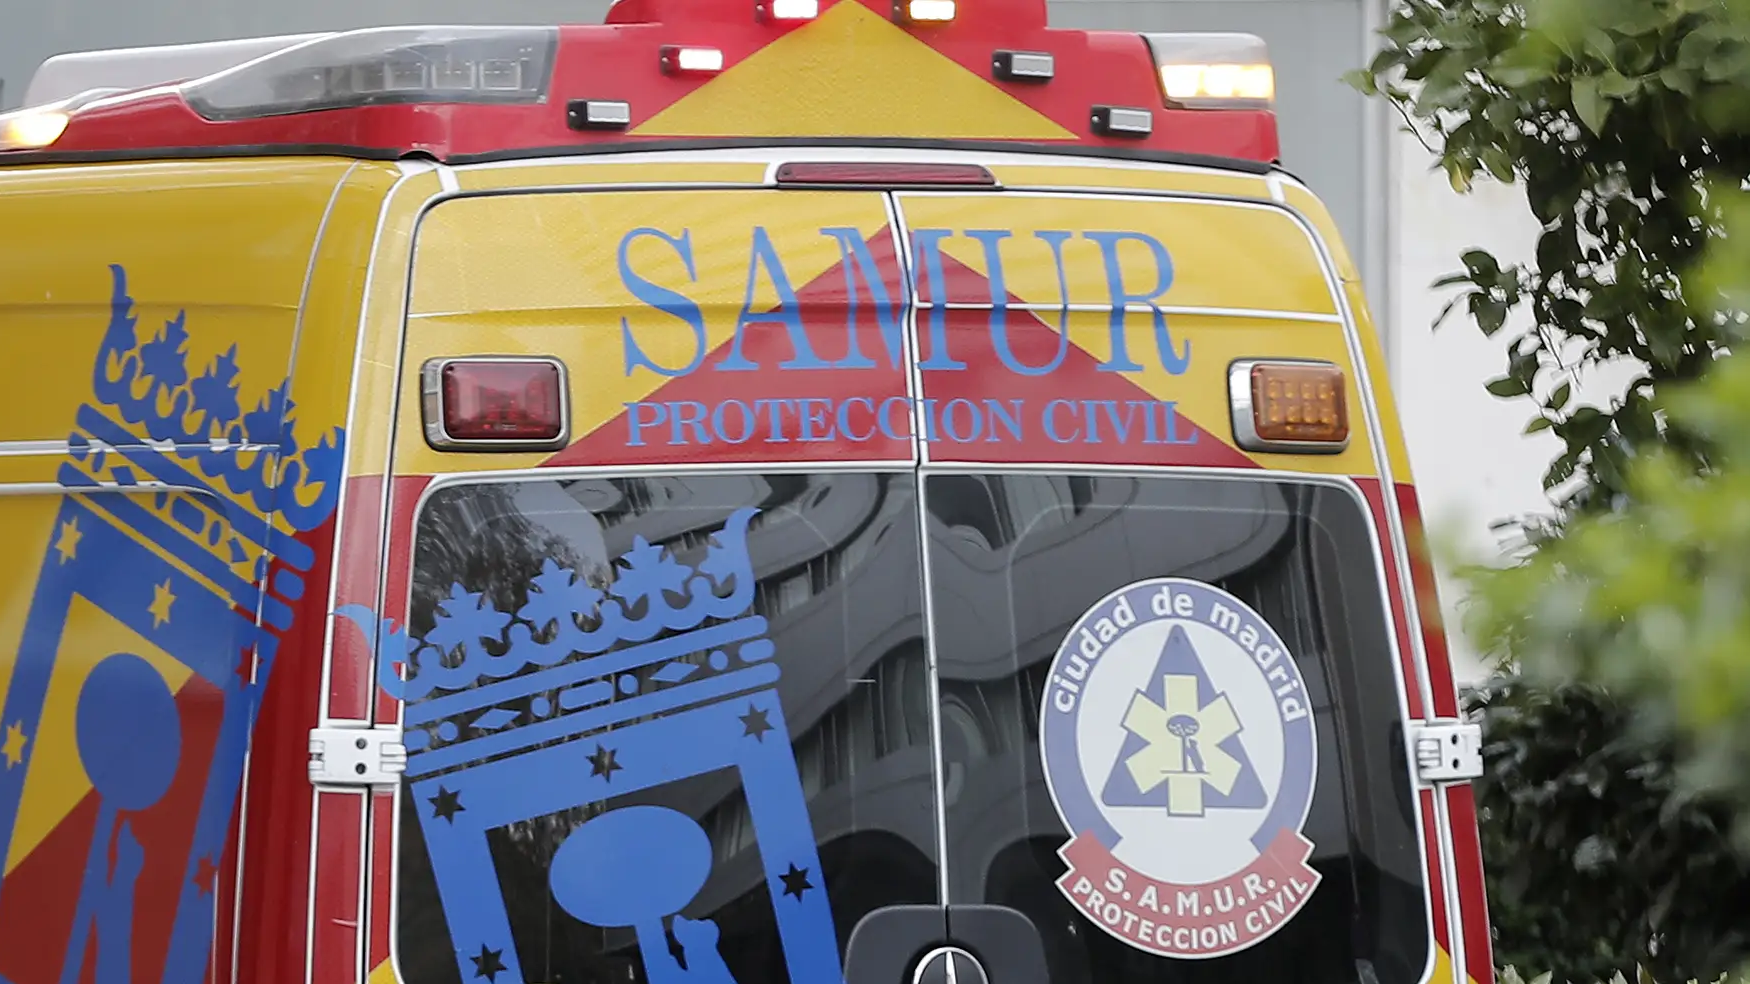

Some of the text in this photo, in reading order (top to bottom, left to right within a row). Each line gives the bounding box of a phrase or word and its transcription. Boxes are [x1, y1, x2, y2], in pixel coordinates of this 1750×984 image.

[617, 226, 1190, 377] SAMUR
[623, 397, 1199, 447] PROTECCION CIVIL
[1054, 586, 1308, 723] ciudad de madrid
[1073, 876, 1309, 950] PROTECCION CIVIL
